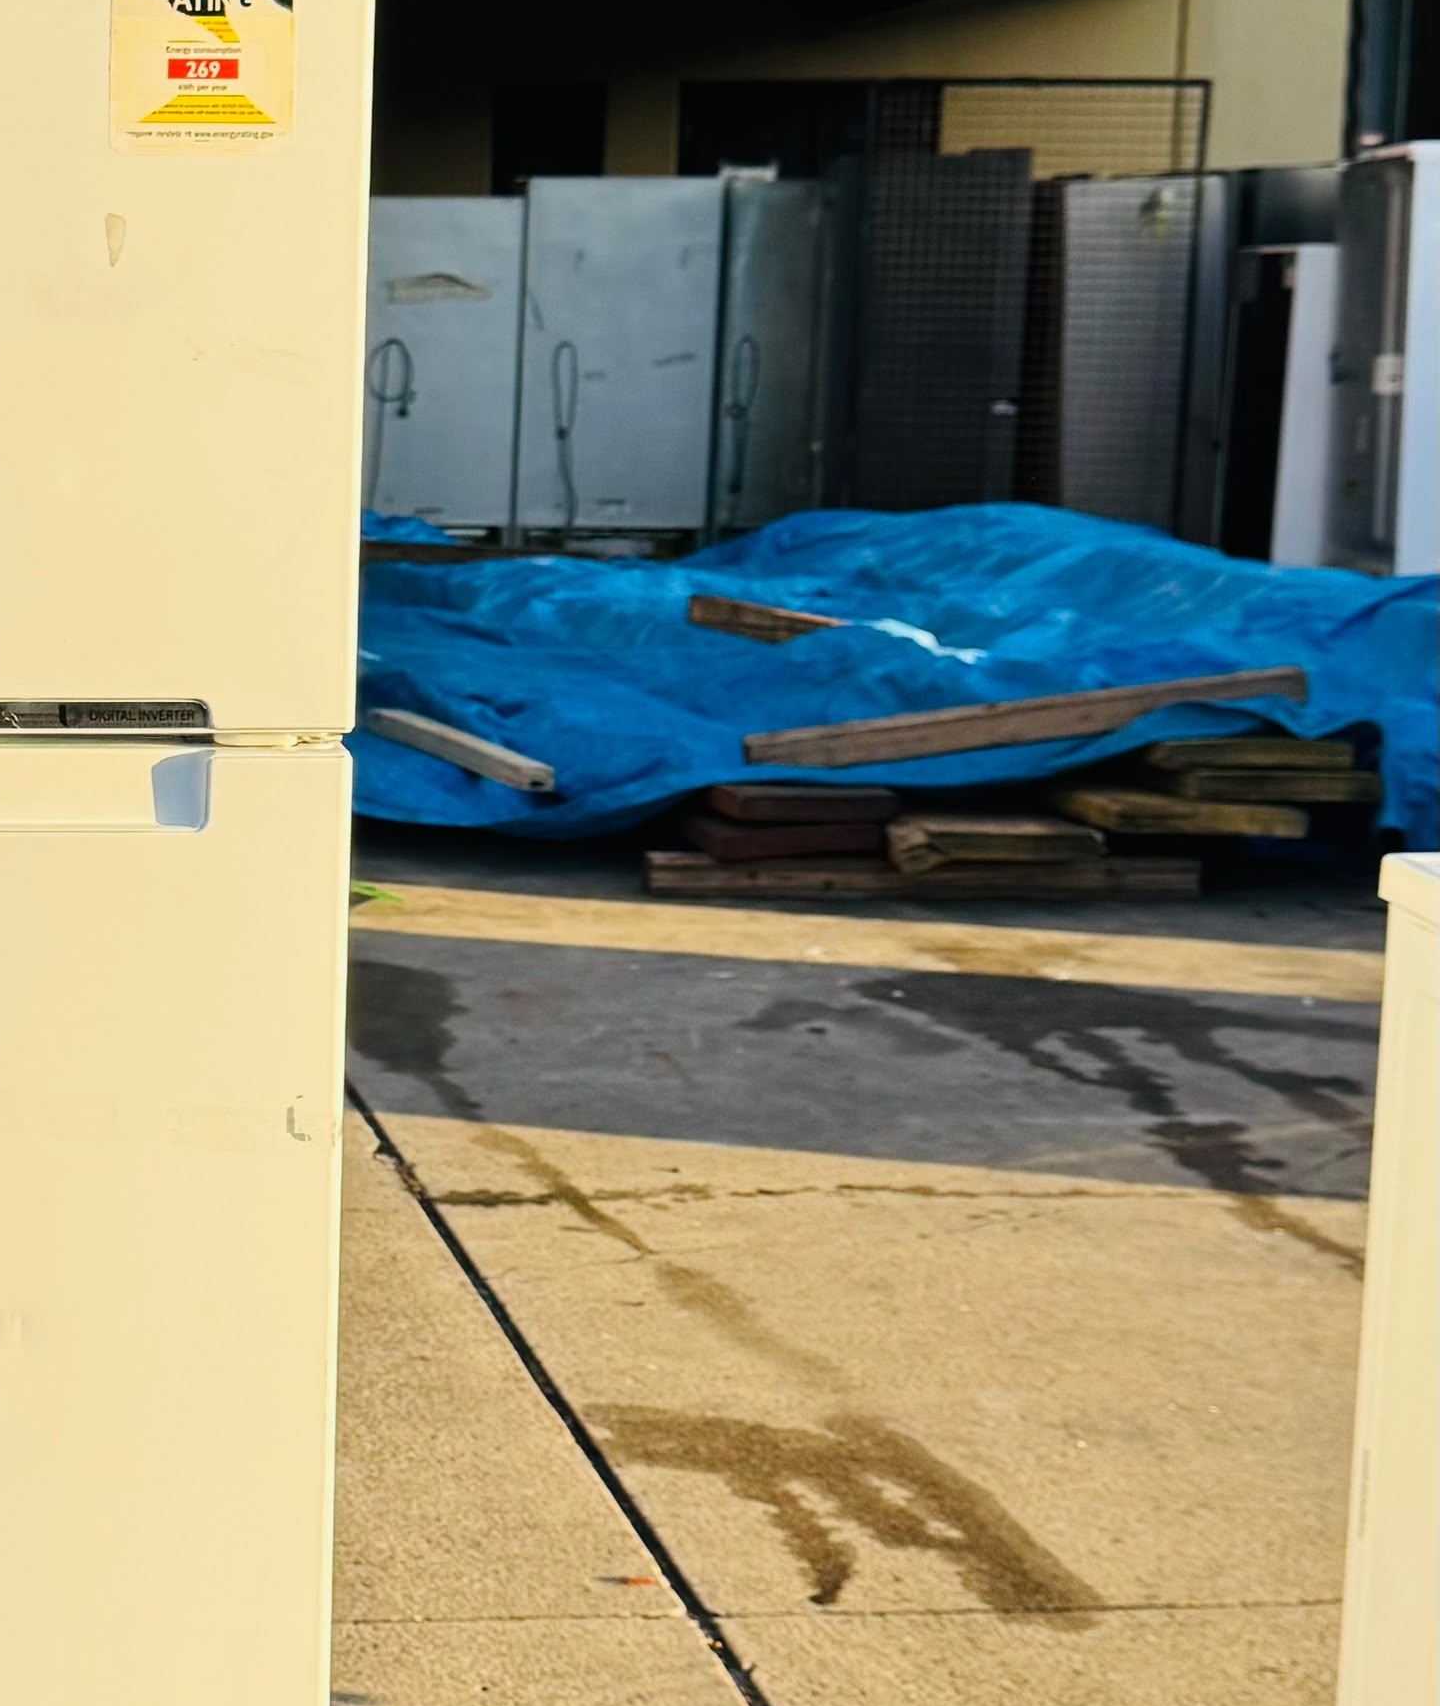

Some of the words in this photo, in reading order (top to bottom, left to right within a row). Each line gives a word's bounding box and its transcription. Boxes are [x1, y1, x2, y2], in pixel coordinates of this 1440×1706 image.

[186, 60, 220, 79] 269
[89, 709, 136, 722] DIGITAL
[139, 708, 195, 721] INVERTER
